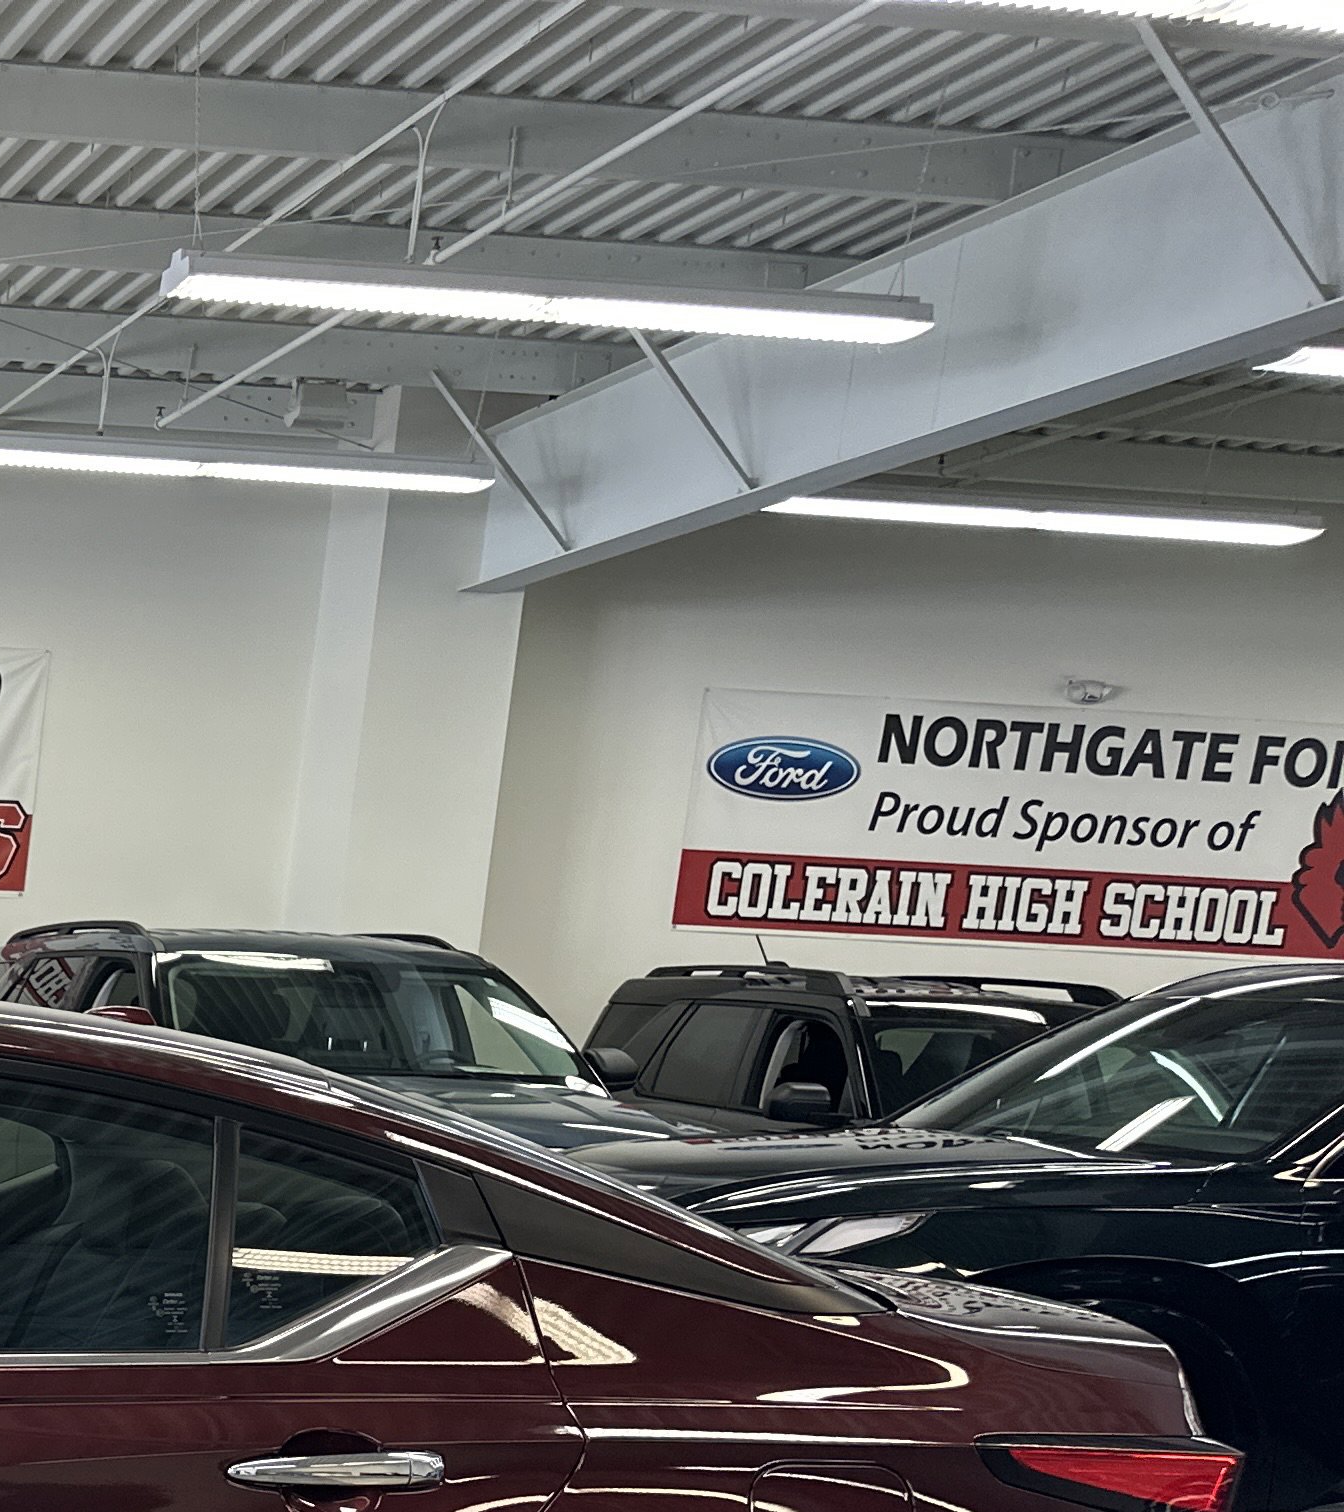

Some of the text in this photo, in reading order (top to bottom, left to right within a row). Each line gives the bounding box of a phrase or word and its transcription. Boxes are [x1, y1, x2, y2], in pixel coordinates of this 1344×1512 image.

[733, 744, 834, 792] Ford
[877, 713, 1240, 783] NORTHGATE
[868, 791, 1262, 852] Proud Sponsor of
[706, 860, 1286, 947] COLERAIN HIGH SCHOOL
